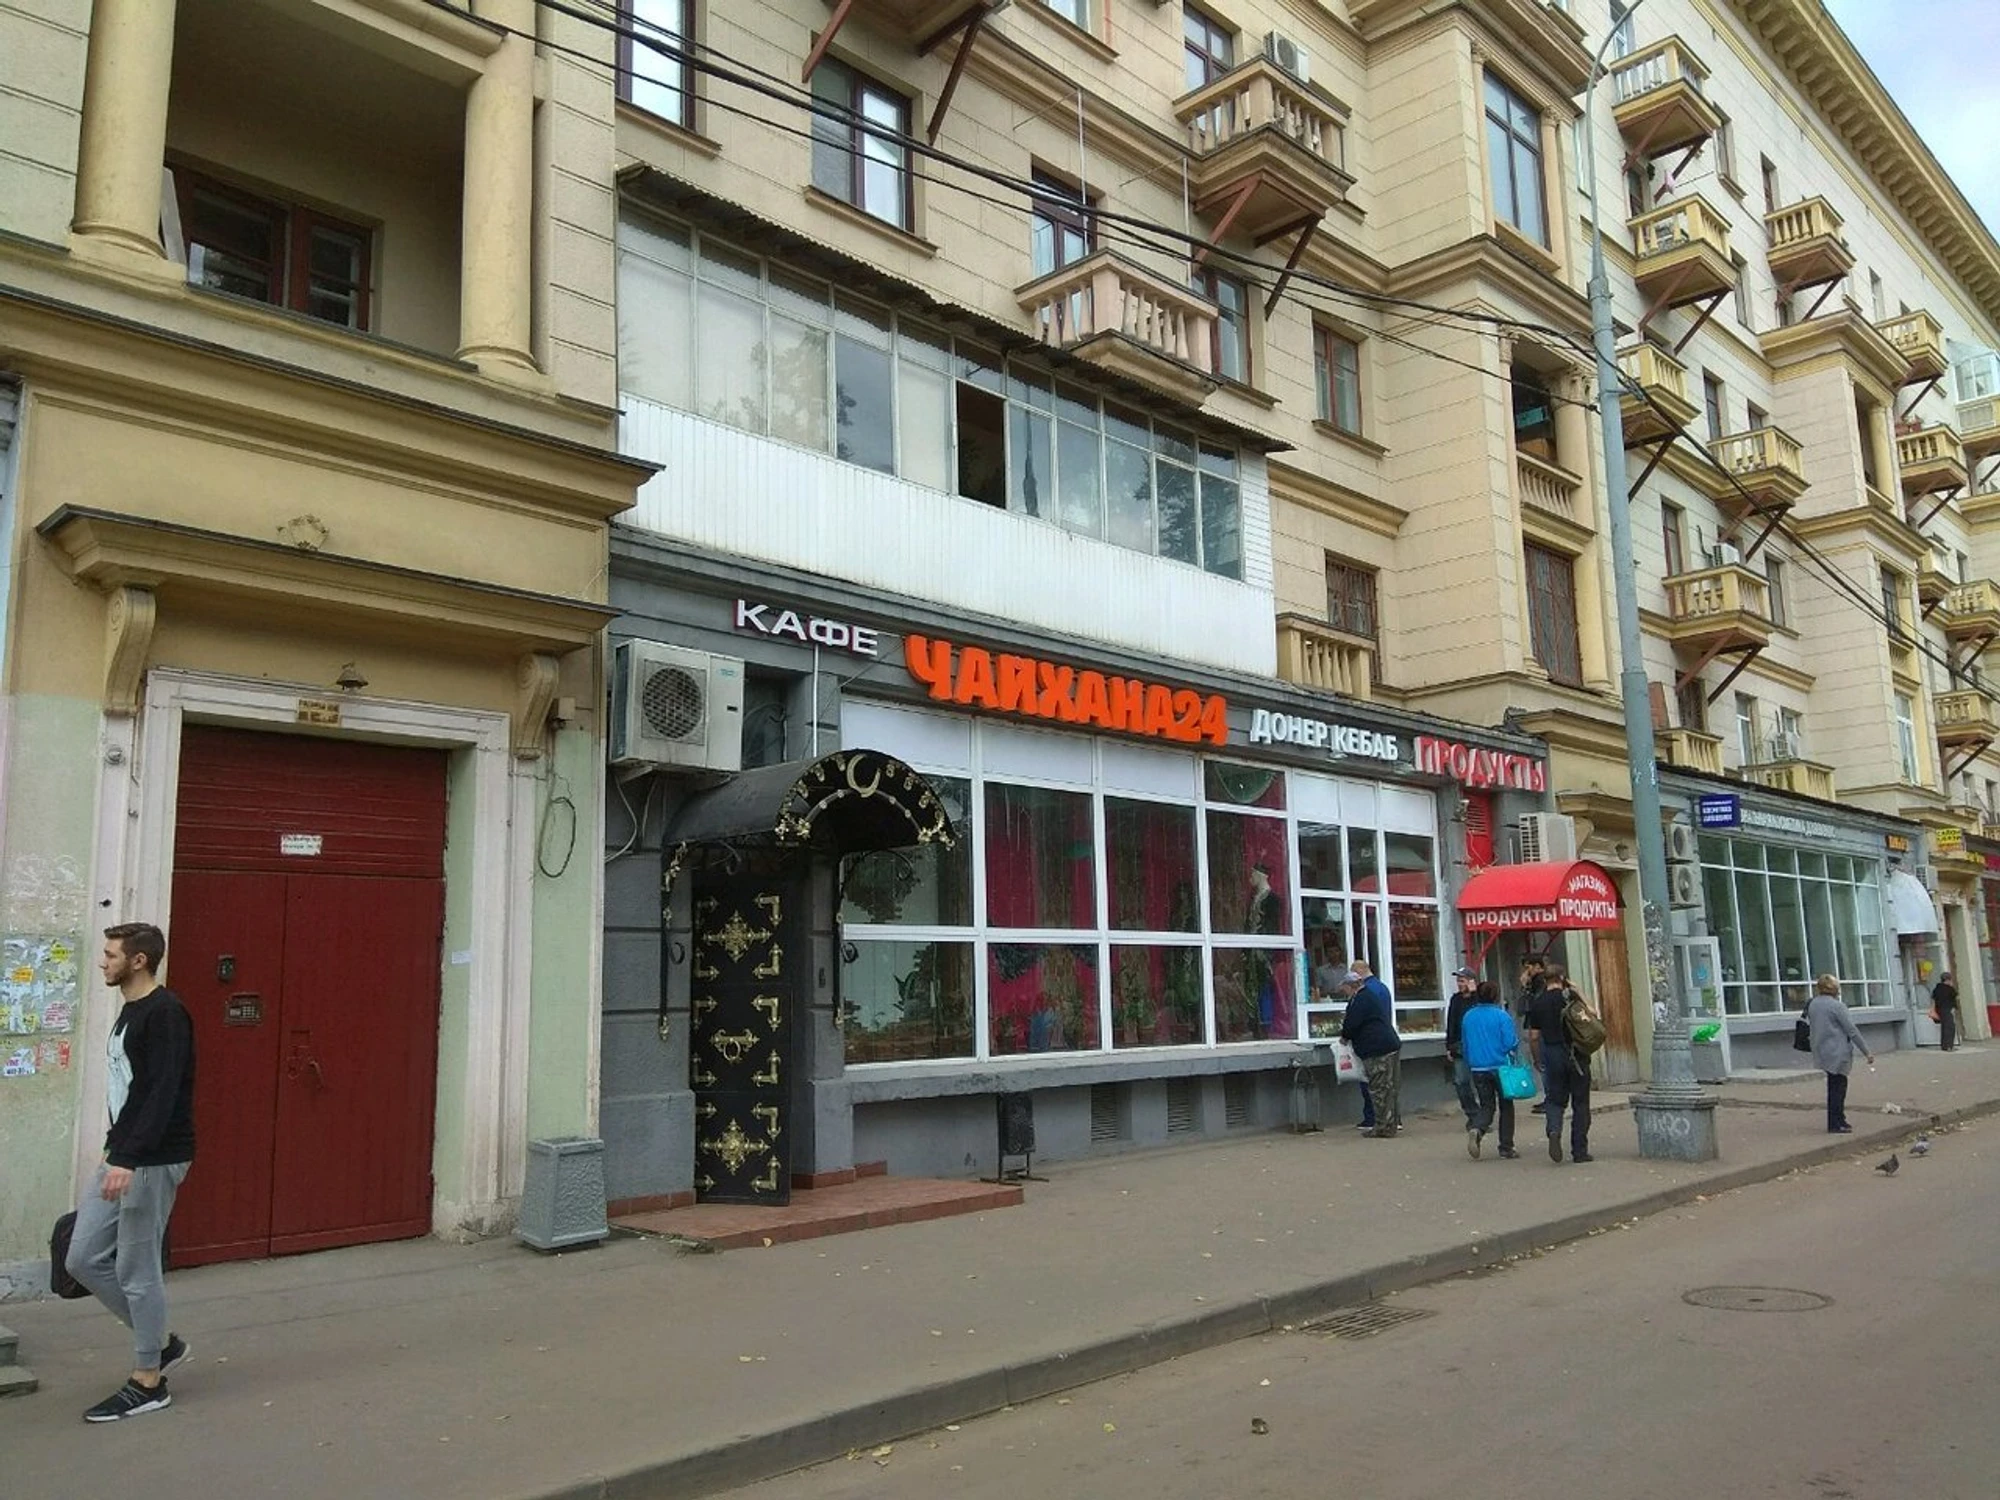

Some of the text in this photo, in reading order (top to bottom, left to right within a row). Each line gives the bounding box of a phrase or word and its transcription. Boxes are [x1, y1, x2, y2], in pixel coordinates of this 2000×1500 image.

[735, 599, 879, 656] КАФЕ
[906, 634, 1228, 746] ЧАЙХАНА24
[1250, 709, 1399, 761] ДОНЕР КЕБАБ
[1413, 735, 1546, 792] ПРОДУКТЫ
[1465, 908, 1558, 926] ПРОДУКТЫ
[1560, 898, 1617, 921] ПРОДУКТЫ
